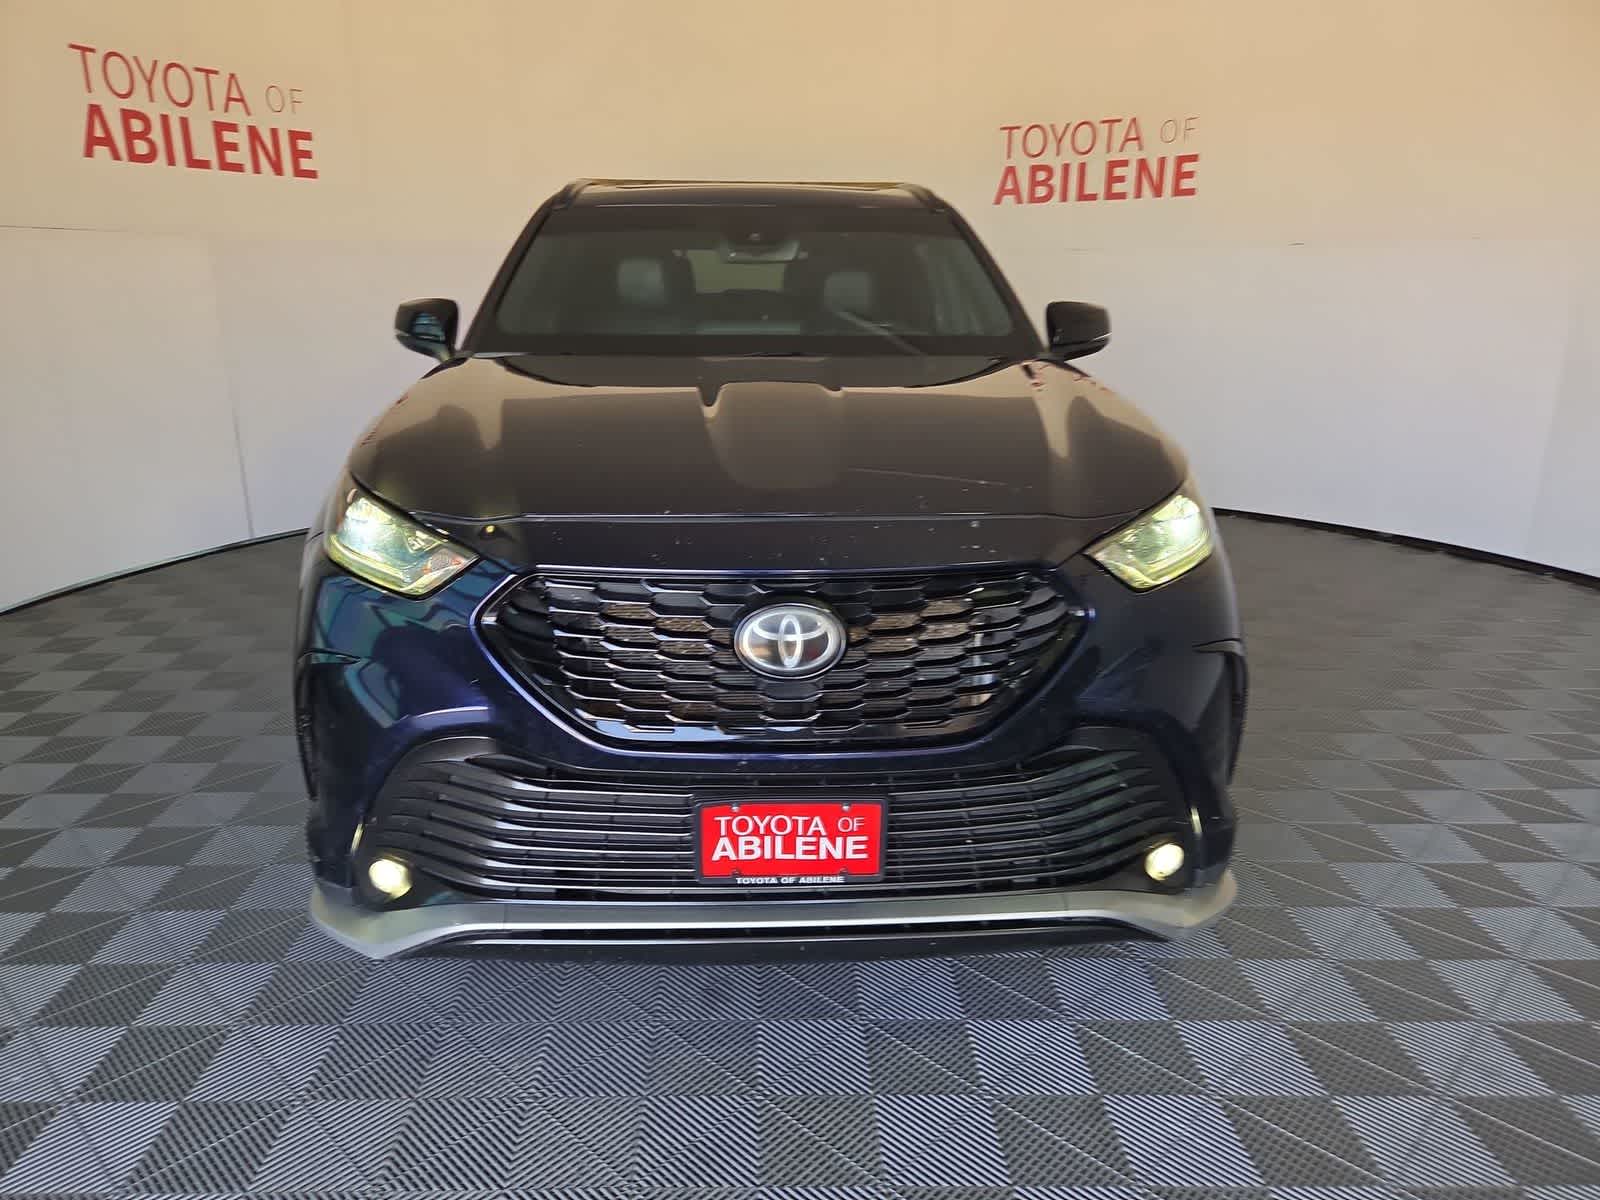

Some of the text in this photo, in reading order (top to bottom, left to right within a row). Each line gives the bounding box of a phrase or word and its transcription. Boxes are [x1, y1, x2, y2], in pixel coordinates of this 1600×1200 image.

[67, 42, 303, 117] TOYOTA OF
[83, 103, 318, 179] ABILENE
[999, 113, 1200, 160] TOYOTA OF
[992, 153, 1200, 206] ABILENE
[711, 835, 870, 861] ABILENE
[714, 815, 865, 836] TOYOTA OF
[735, 875, 846, 885] TOYOTA OF ABILENE
